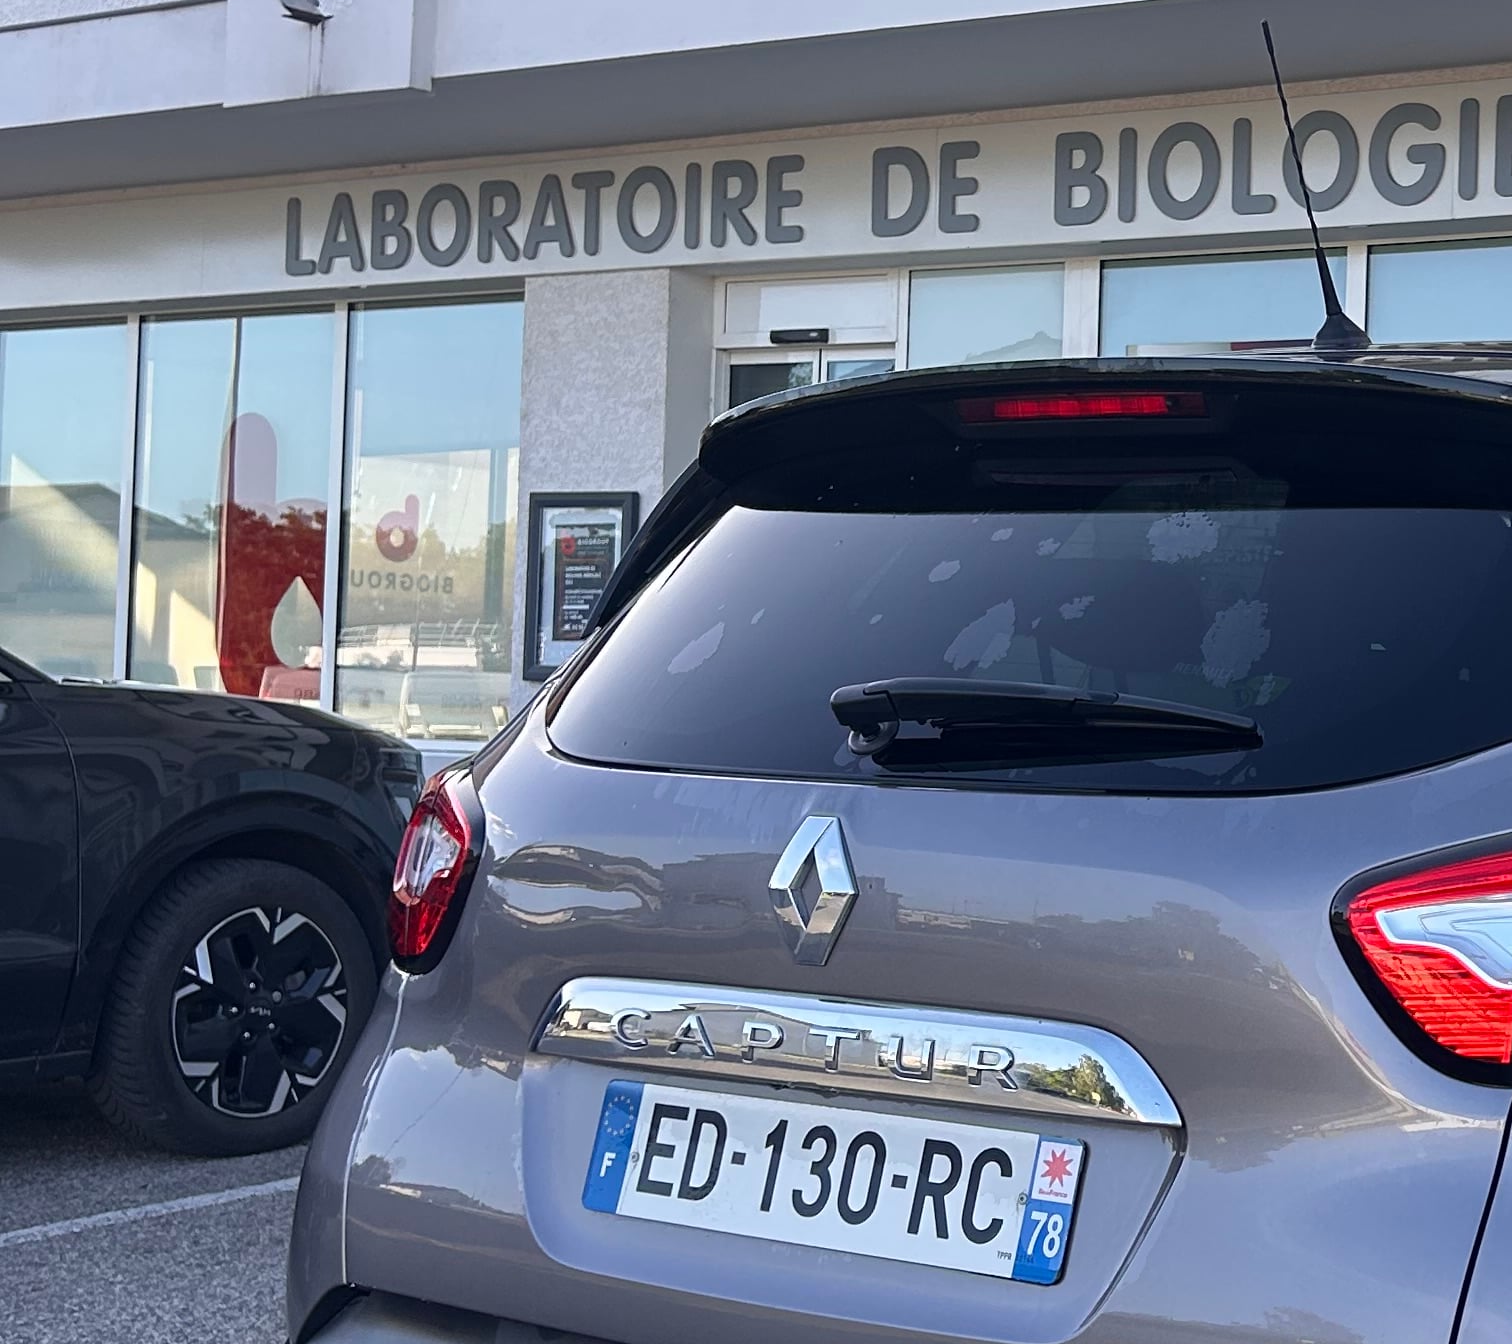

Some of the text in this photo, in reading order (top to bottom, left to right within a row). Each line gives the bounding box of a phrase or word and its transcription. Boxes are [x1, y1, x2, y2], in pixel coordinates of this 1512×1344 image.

[285, 154, 805, 277] LABORATOIRE
[871, 140, 980, 238] DE
[610, 1008, 1019, 1092] CAPTUR
[600, 1103, 1064, 1259] F ED-130-RC 78
